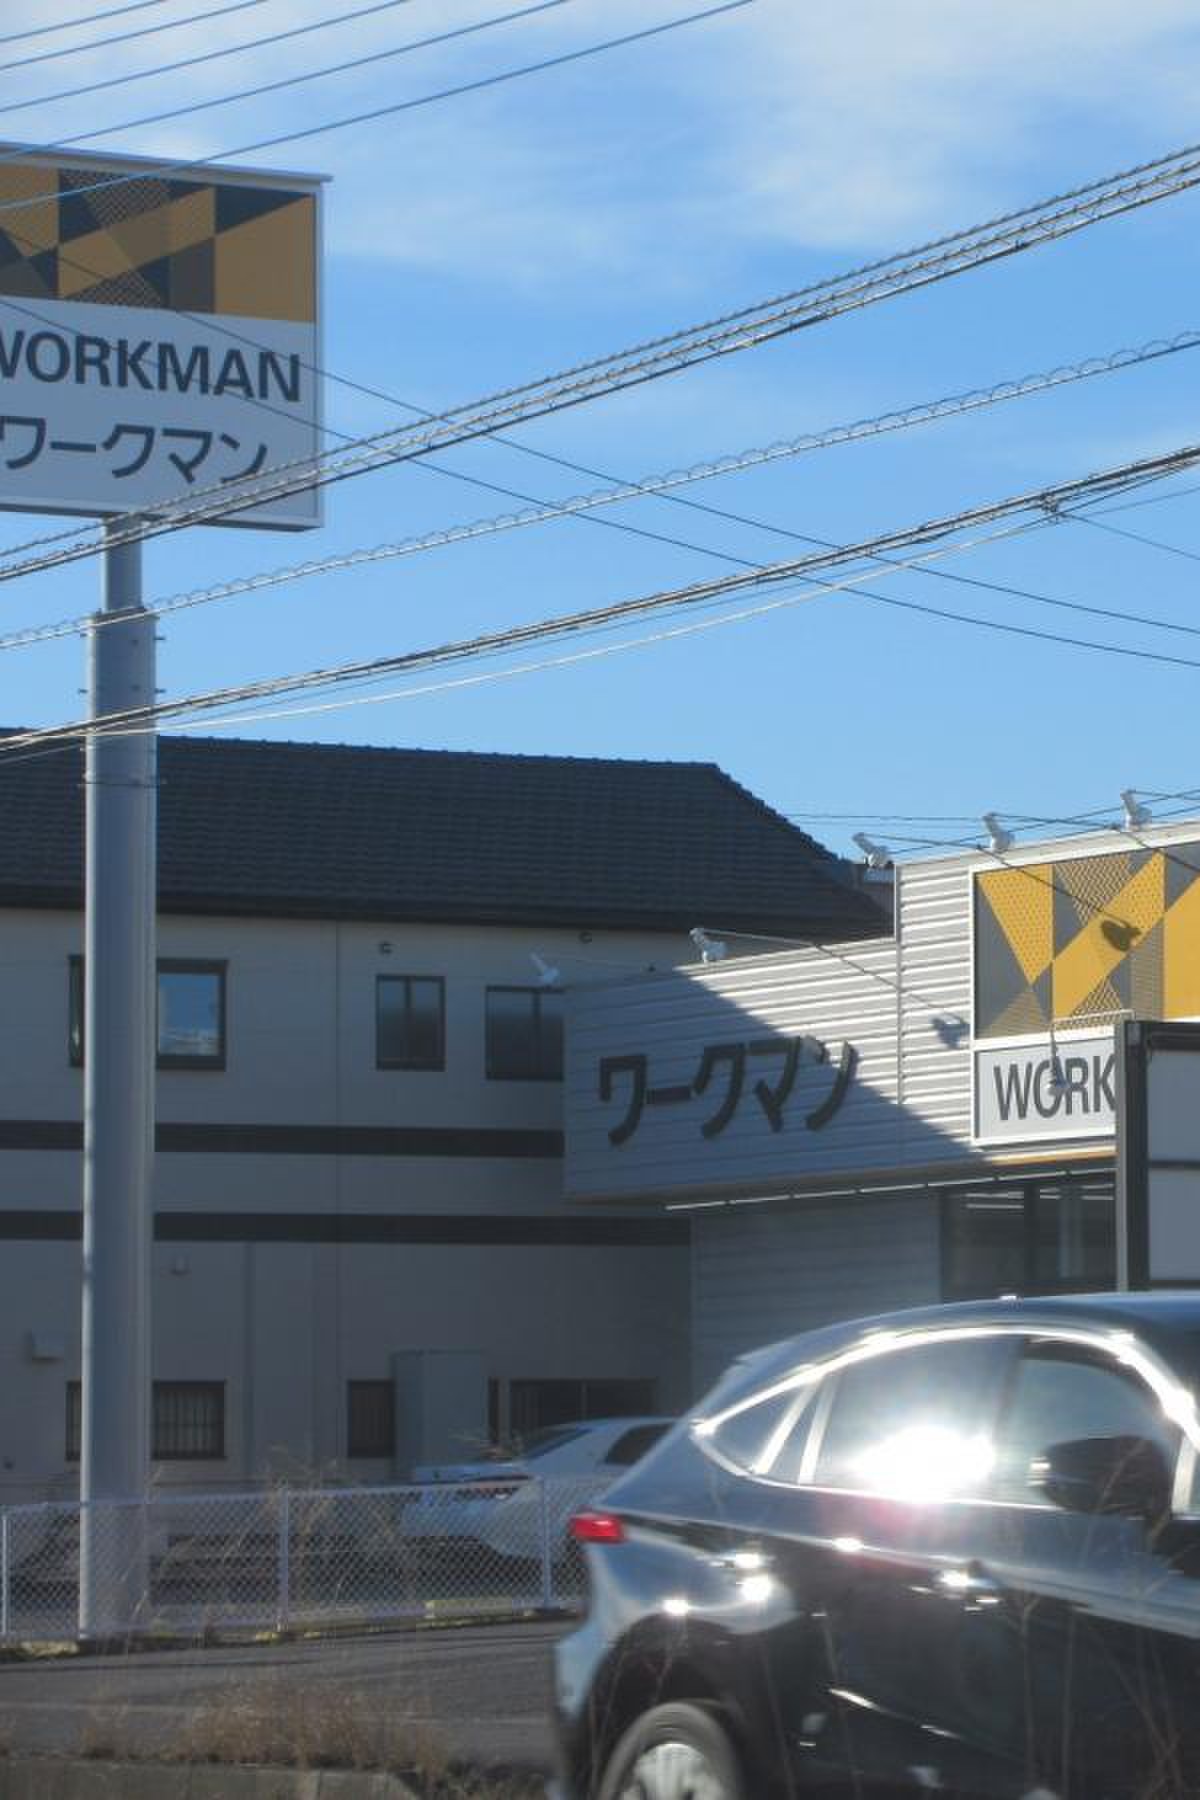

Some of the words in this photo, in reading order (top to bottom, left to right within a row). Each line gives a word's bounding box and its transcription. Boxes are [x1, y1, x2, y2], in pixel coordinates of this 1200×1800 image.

[0, 414, 267, 485] ワークマン
[599, 1035, 858, 1146] ワークマン
